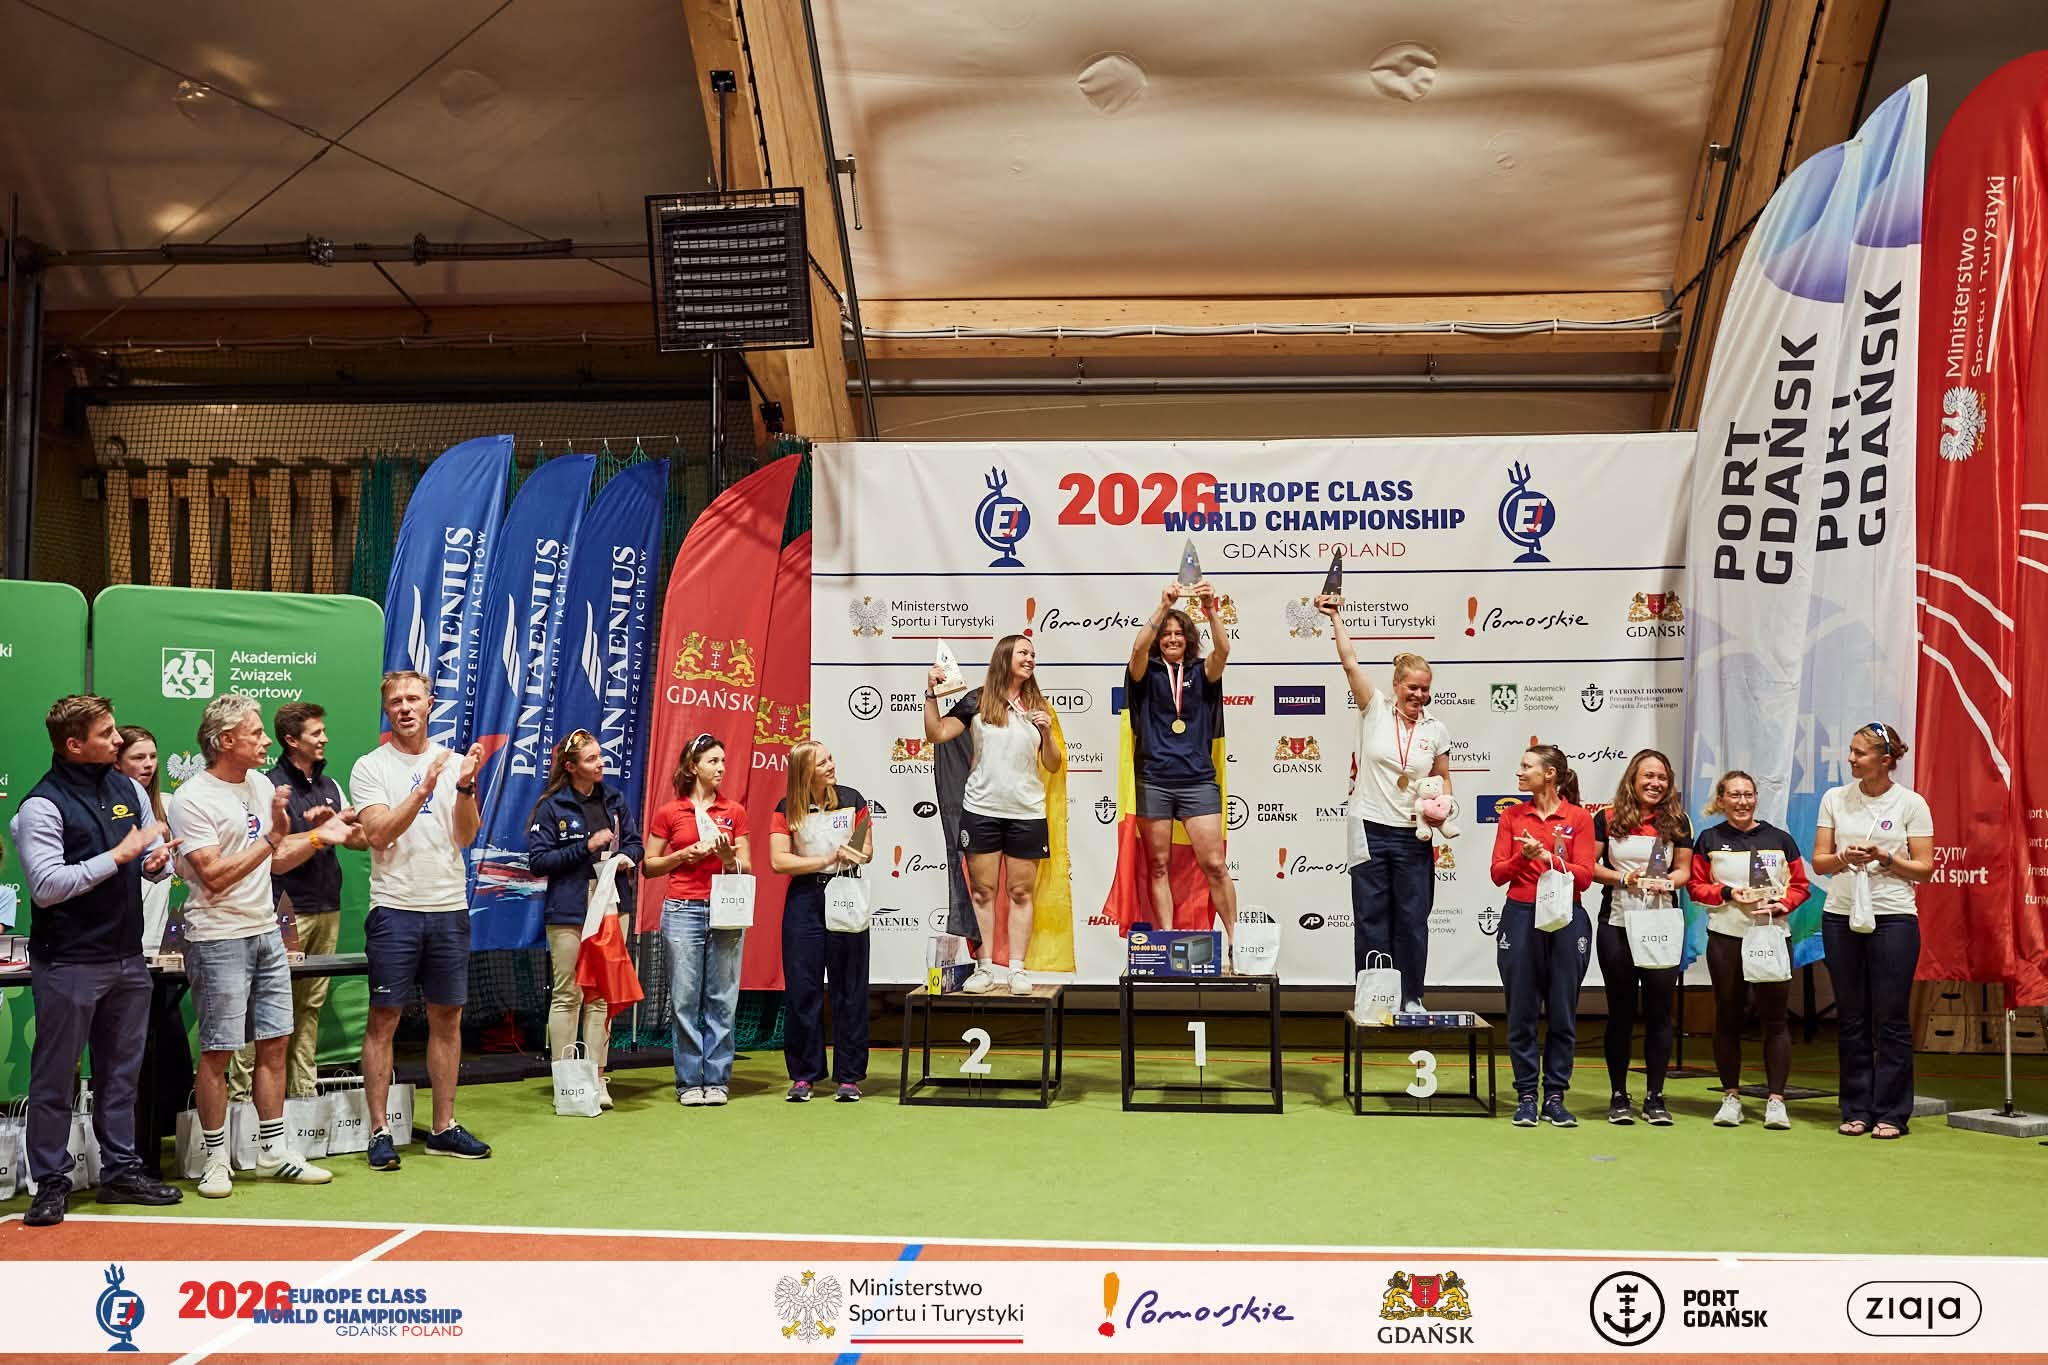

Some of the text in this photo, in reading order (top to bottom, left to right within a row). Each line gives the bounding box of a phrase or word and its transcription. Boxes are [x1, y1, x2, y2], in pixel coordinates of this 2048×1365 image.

[1971, 299, 1986, 377] Sportu
[1979, 175, 2005, 281] Turystyki
[1945, 226, 1977, 378] Ministerstwo
[1852, 280, 1902, 547] GDAŃSK
[1756, 332, 1818, 584] GDAŃSK
[1058, 472, 1414, 526] 2026 EUROPE CLASS
[1713, 421, 1760, 580] PORT
[1163, 508, 1466, 532] WORLD CHAMPIONSHIP
[1222, 539, 1406, 559] GDAŃSK POLAND
[891, 600, 969, 612] Ministerstwo
[891, 616, 931, 629] Sportu
[941, 616, 995, 629] Turystyki
[1040, 608, 1144, 632] Pomorskie
[1380, 615, 1436, 629] Turystyki
[1482, 607, 1589, 632] Pomorskie
[1626, 623, 1685, 638] GDAŃSK
[427, 526, 474, 751] ANTAENIUS
[229, 651, 317, 665] Akademicki
[510, 538, 560, 778] PANTAENIUS
[601, 545, 636, 778] PANTAENIUS
[229, 667, 292, 684] Związek
[229, 685, 303, 700] Sportowy
[460, 628, 481, 750] EZPIECZENIA
[1523, 684, 1566, 693] Akademicki
[1647, 687, 1684, 695] HONOROW
[666, 685, 755, 712] GDAŃSK
[890, 693, 917, 702] PORT
[1221, 694, 1255, 705] RKEN
[624, 640, 643, 779] UBEZPIECZENIA
[890, 701, 925, 712] GDAŃS
[1523, 703, 1560, 712] Sportowy
[1449, 751, 1491, 762] urystyki
[1273, 762, 1323, 774] GDAŃSK
[1257, 803, 1284, 812] PORT
[1257, 811, 1298, 822] GDAŃSK
[720, 897, 745, 907] ziaja
[832, 900, 854, 909] ziaja
[871, 917, 919, 927] TAENIUS
[1641, 934, 1668, 945] ziaja
[1240, 946, 1264, 955] ziaja
[1749, 948, 1774, 960] ziaja
[1371, 994, 1395, 1004] ziaja
[959, 1027, 992, 1074] 2
[1187, 1022, 1206, 1066] 1
[1406, 1050, 1437, 1098] 3
[560, 1087, 585, 1097] ziaja
[337, 1118, 361, 1129] ziaja
[297, 1128, 325, 1139] ziaja
